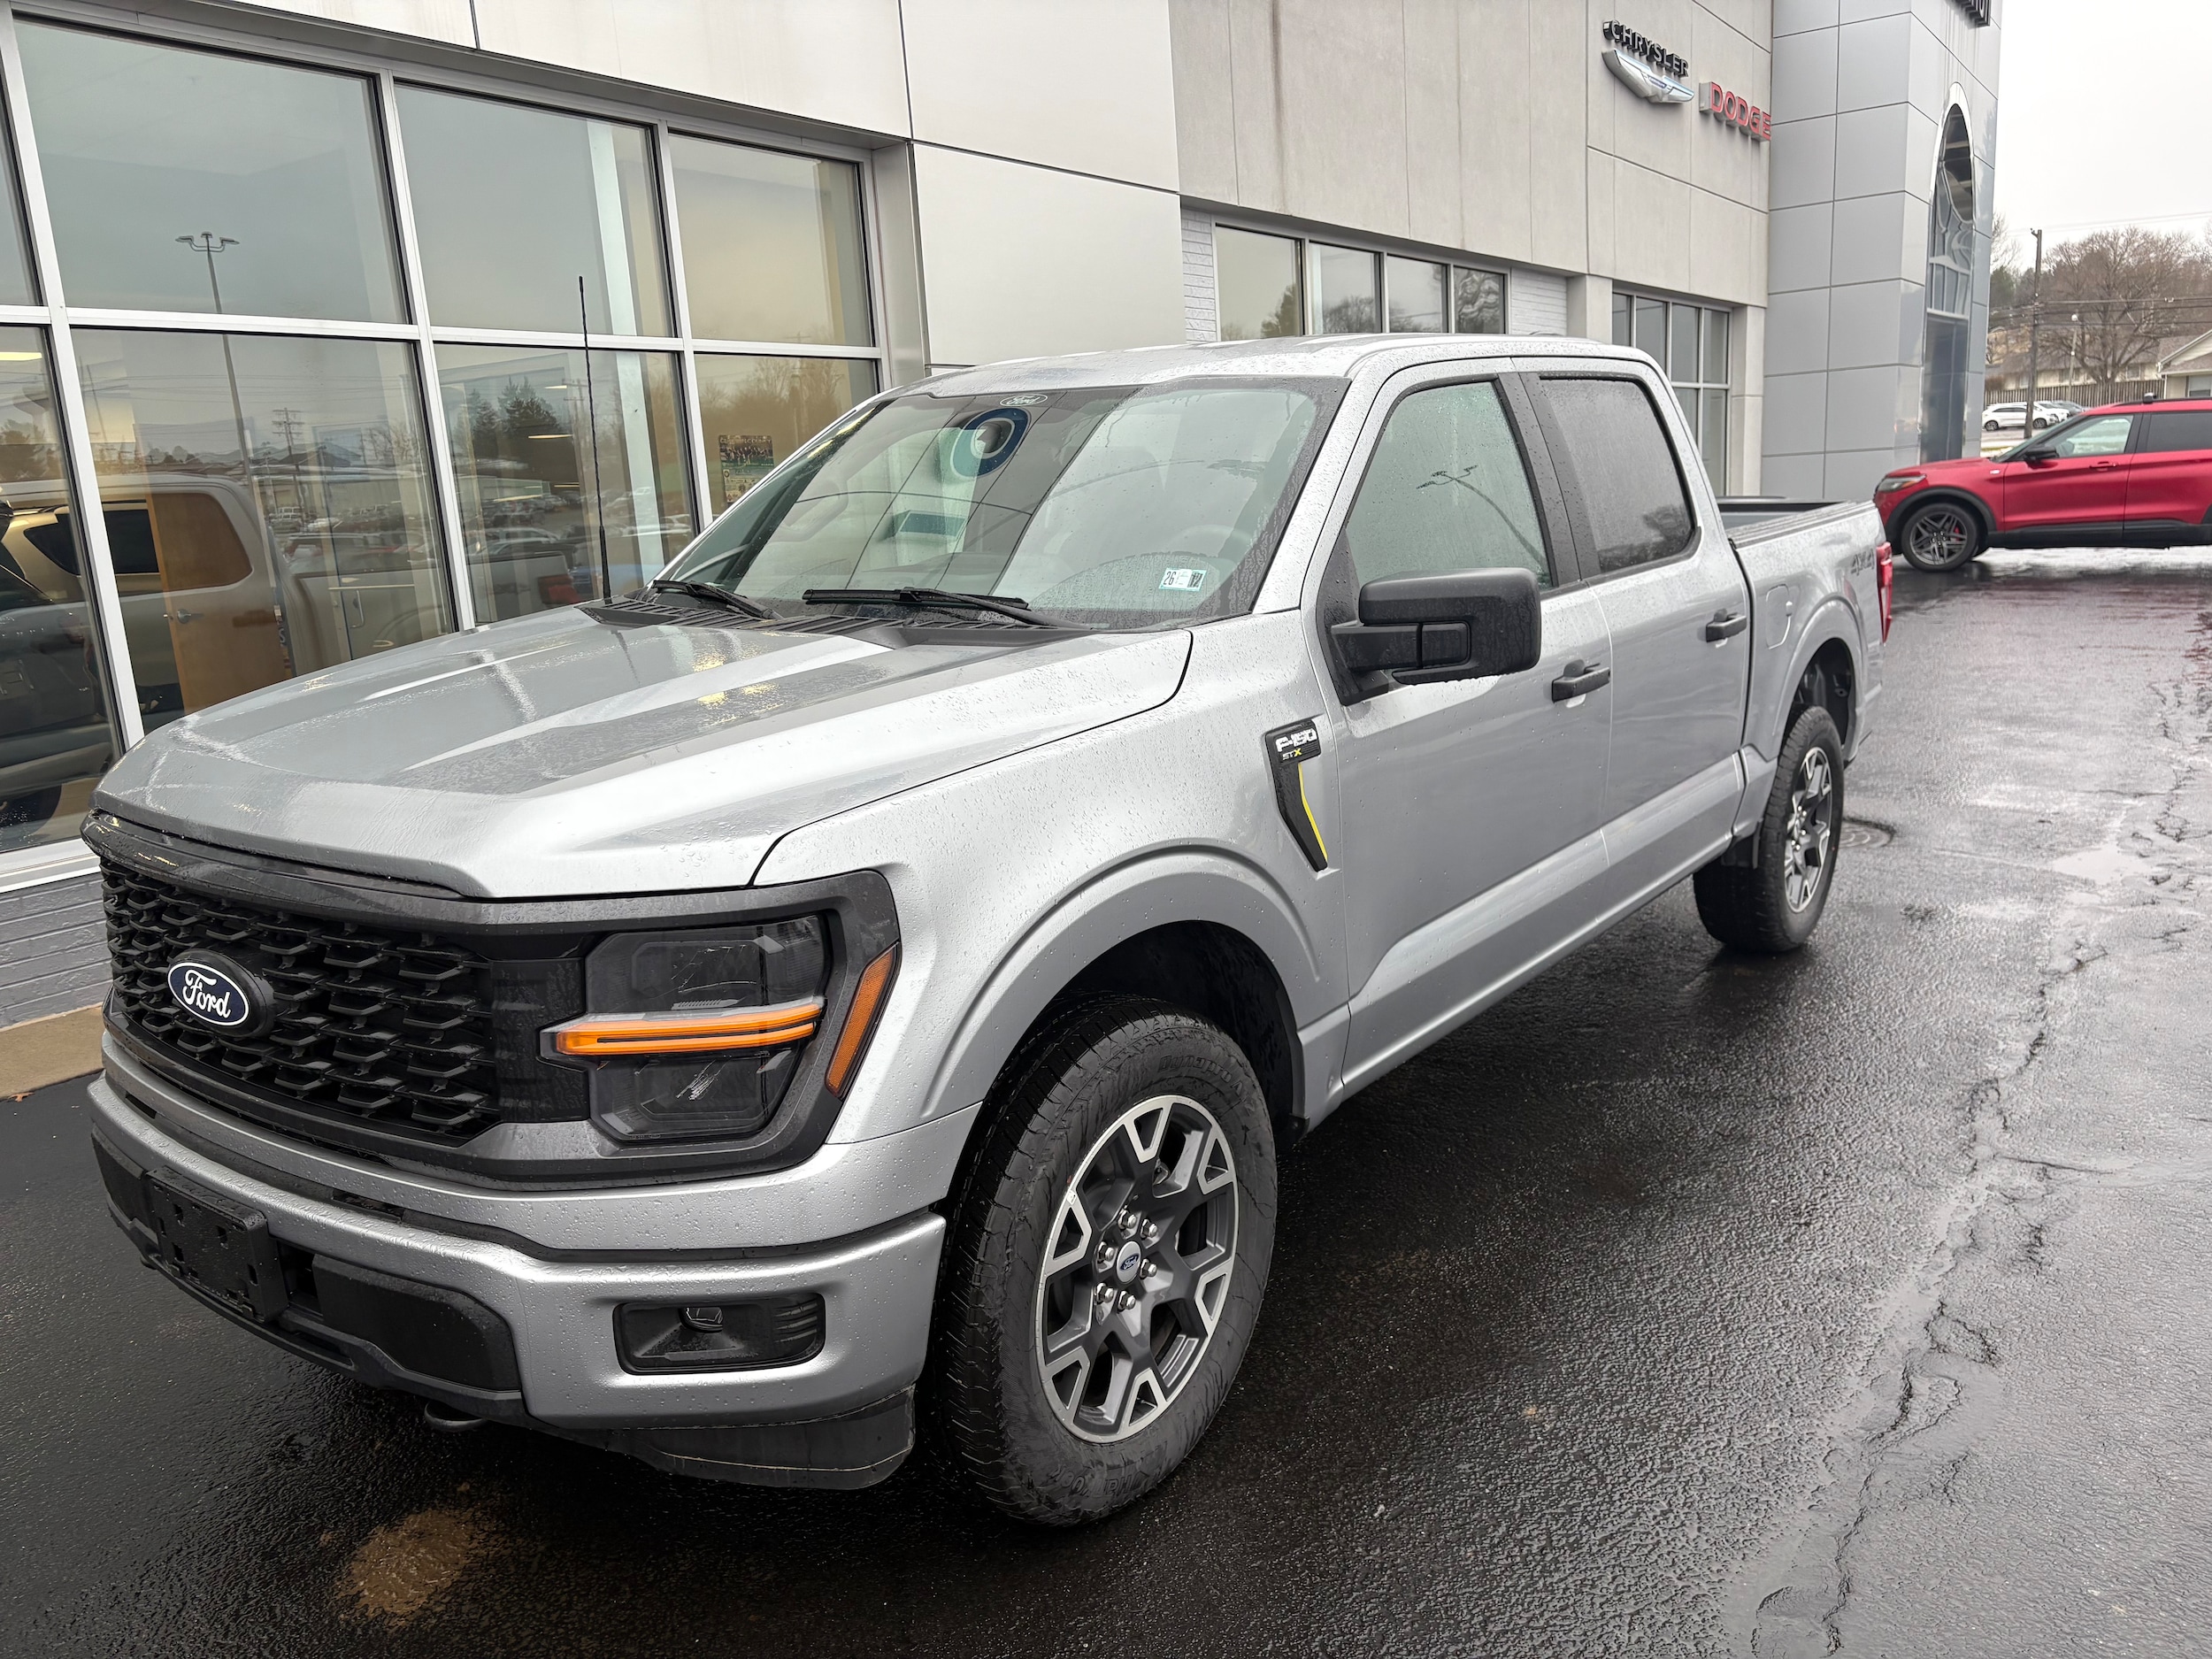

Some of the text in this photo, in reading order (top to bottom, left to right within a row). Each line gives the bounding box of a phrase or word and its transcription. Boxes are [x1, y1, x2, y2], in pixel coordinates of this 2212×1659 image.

[1604, 20, 1689, 77] CHRYSLER
[1709, 81, 1770, 141] DODGE
[1163, 571, 1177, 586] 26
[1275, 728, 1317, 752] F-150
[1282, 748, 1302, 760] STX
[182, 969, 231, 1018] Ford
[1121, 1254, 1139, 1270] Ford
